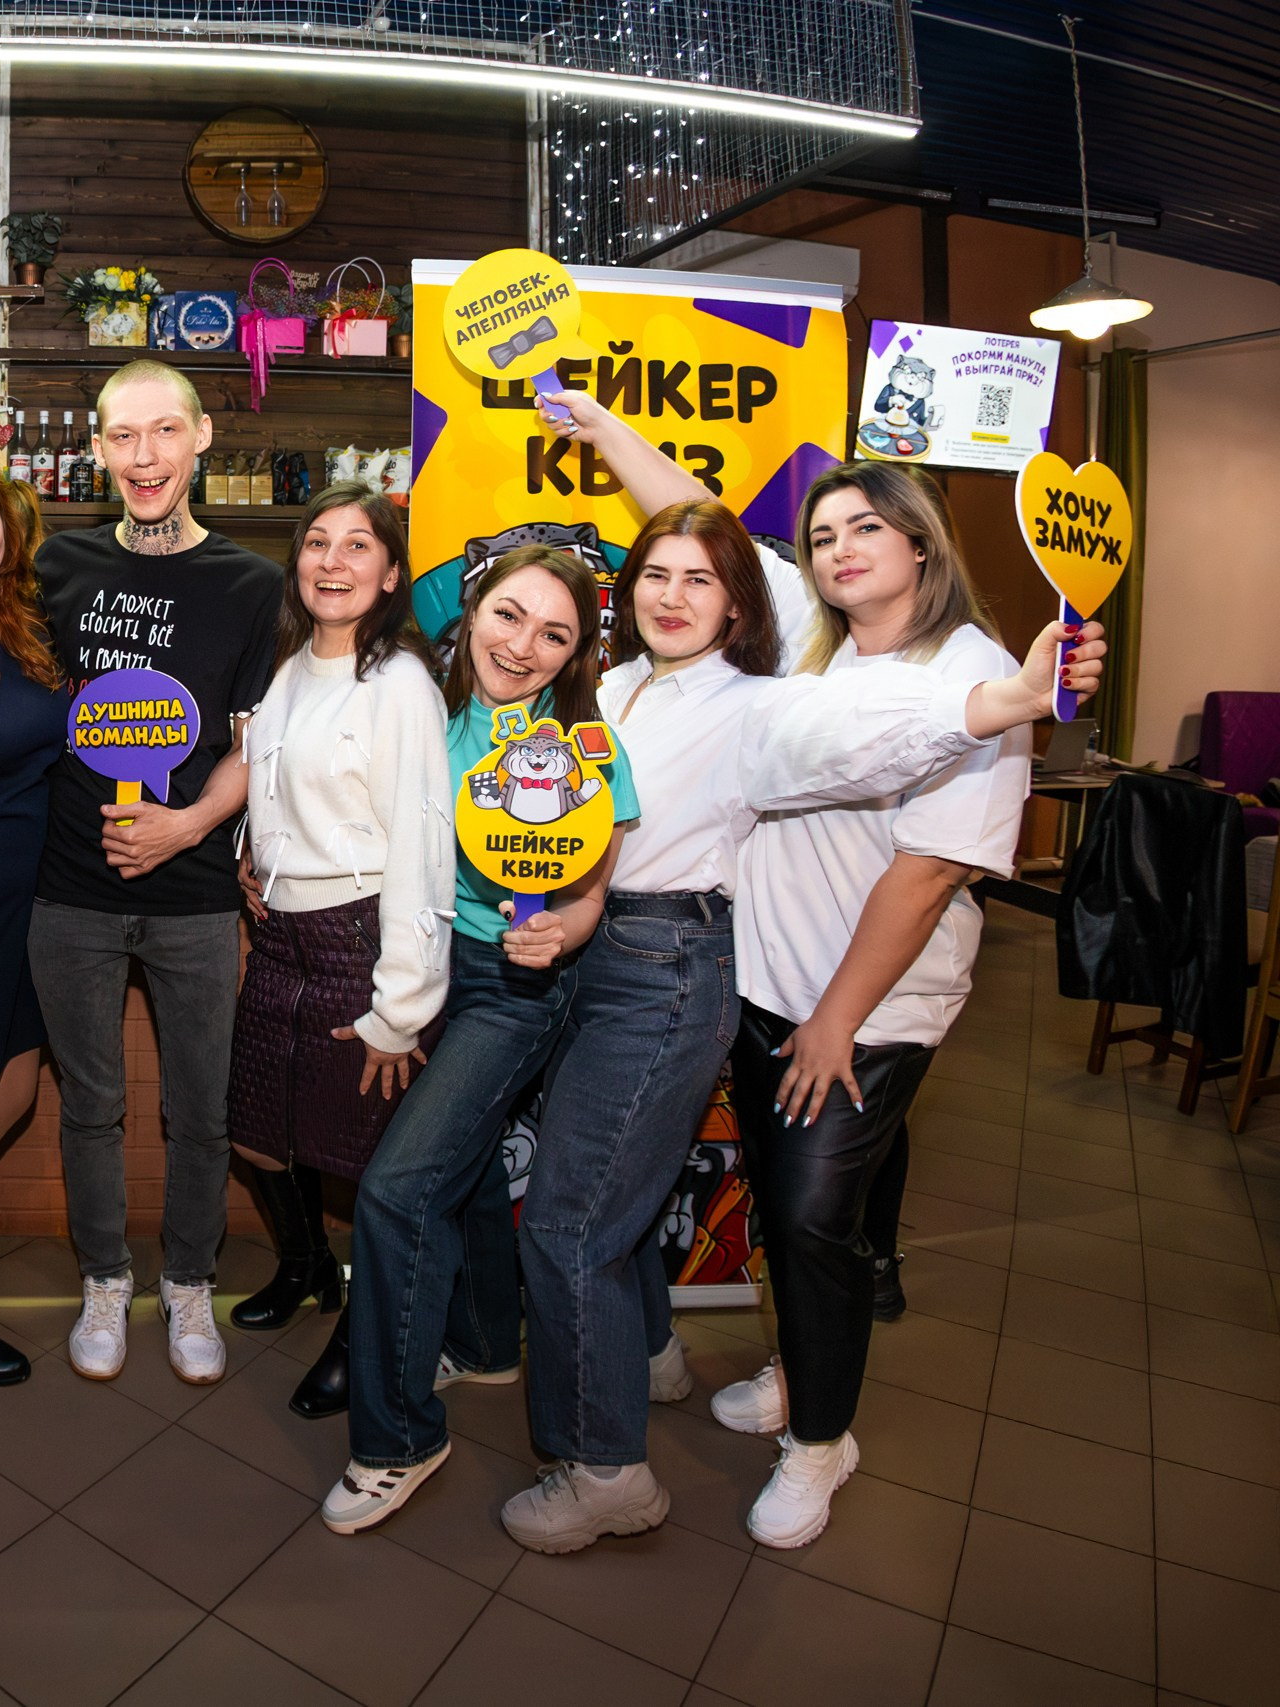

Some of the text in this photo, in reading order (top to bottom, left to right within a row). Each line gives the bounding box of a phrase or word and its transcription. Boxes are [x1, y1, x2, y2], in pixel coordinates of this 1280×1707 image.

[455, 272, 551, 322] ЧЕЛОВЕК-
[456, 283, 570, 345] АПЕЛЛЯЦИЯ
[984, 337, 1020, 348] ЛОТЕРЕЯ
[951, 350, 1047, 376] ПОКОРМИ МАНУЛА
[955, 364, 1043, 387] И ВЫИГРАЙ ПРИЗ!
[527, 436, 725, 497] КВЗ
[1045, 487, 1112, 529] ХОЧУ
[1035, 517, 1123, 566] ЗАМУЖ
[93, 589, 175, 621] А МОЖЕТ
[79, 611, 175, 648] БРОСИТЬ ВСЁ
[79, 646, 153, 670] И РВАНУТЬ
[75, 698, 186, 724] ДУШНИЛА
[74, 724, 189, 748] КОМАНДЫ
[485, 831, 585, 855] ШЕЙКЕР
[501, 860, 565, 880] КВИЗ
